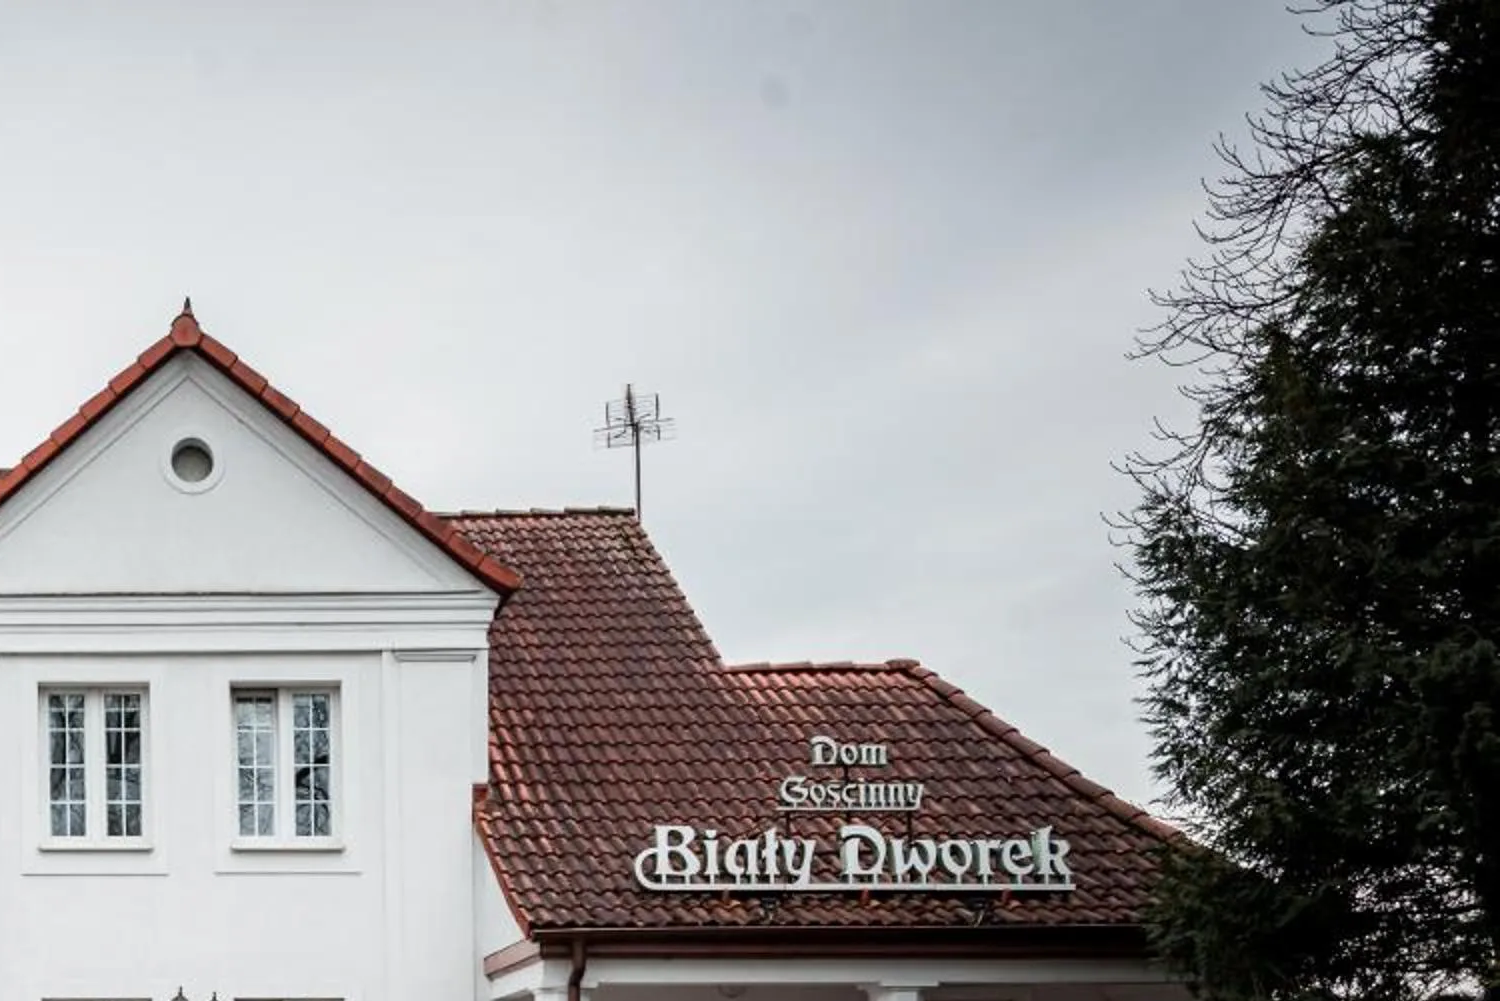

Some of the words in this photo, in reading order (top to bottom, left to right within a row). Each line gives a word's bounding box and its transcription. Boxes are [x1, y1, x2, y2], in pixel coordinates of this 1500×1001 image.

[810, 736, 888, 765] Dom
[634, 825, 816, 890] Biały
[840, 825, 1074, 876] Dworek
